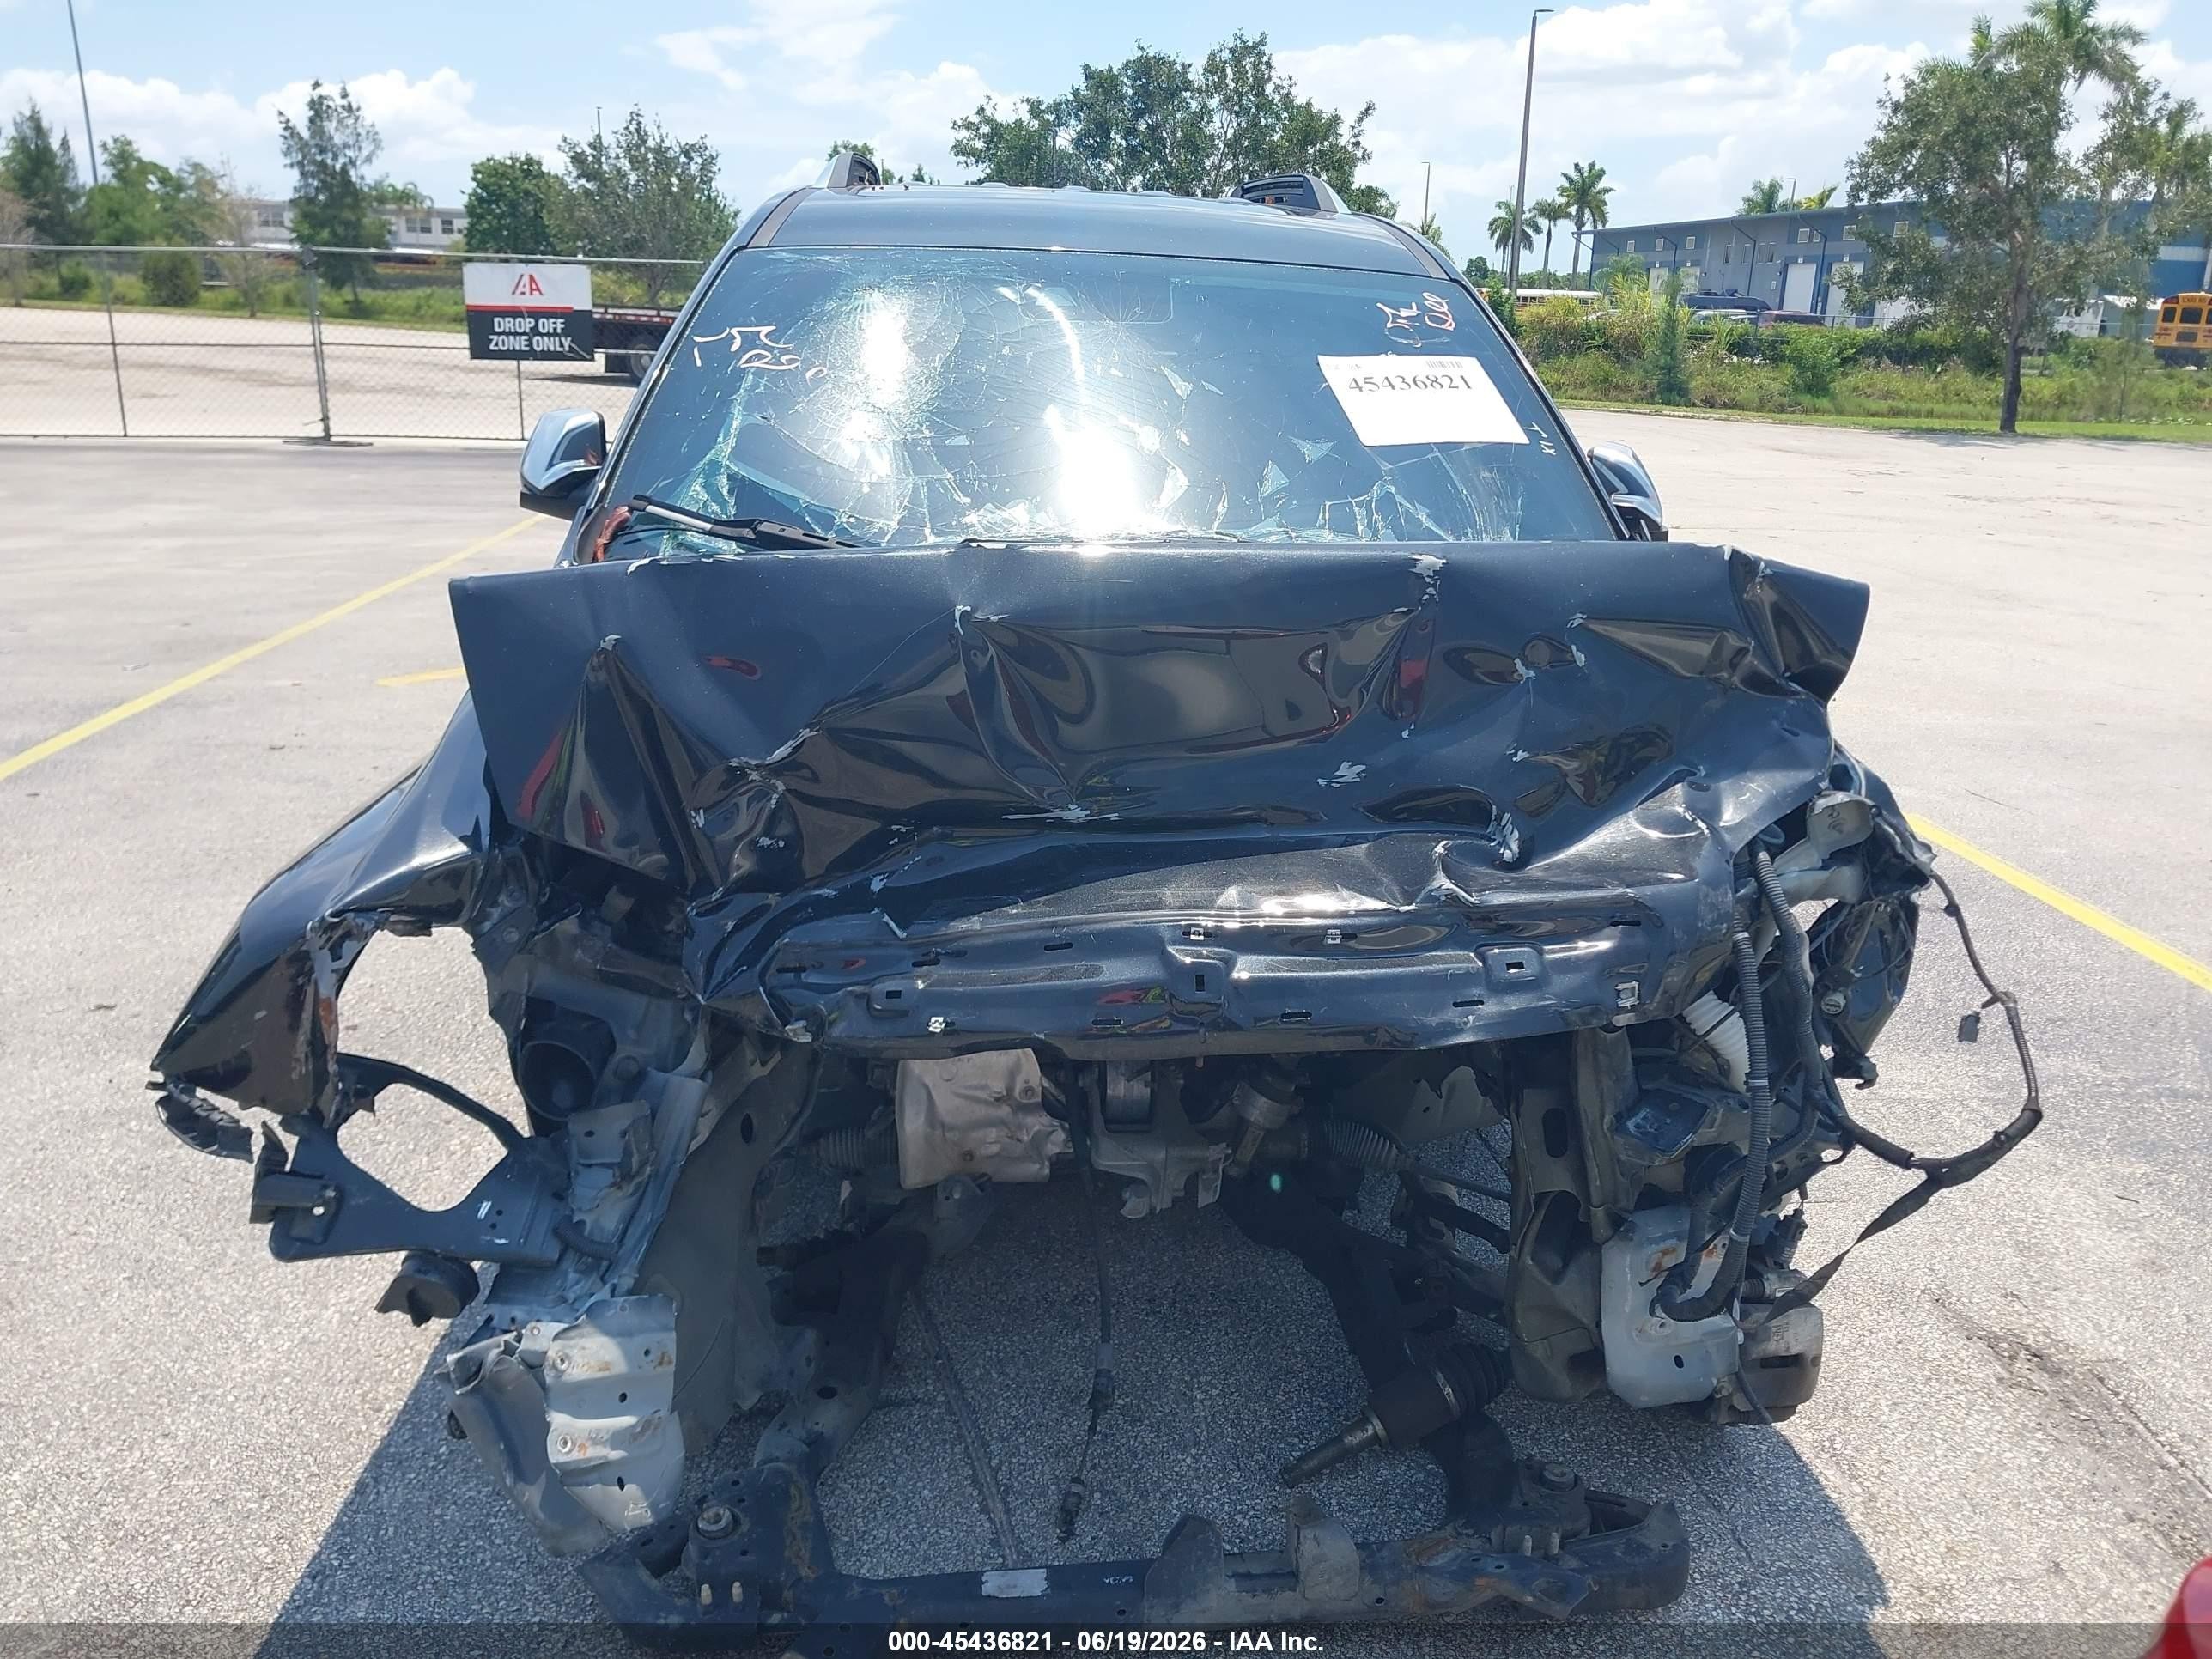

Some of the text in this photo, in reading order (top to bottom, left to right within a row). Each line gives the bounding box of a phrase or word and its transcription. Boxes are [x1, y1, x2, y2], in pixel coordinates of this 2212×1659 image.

[494, 317, 565, 334] DROP OFF
[489, 335, 572, 352] ZONE ONLY
[1348, 374, 1473, 392] 45436821
